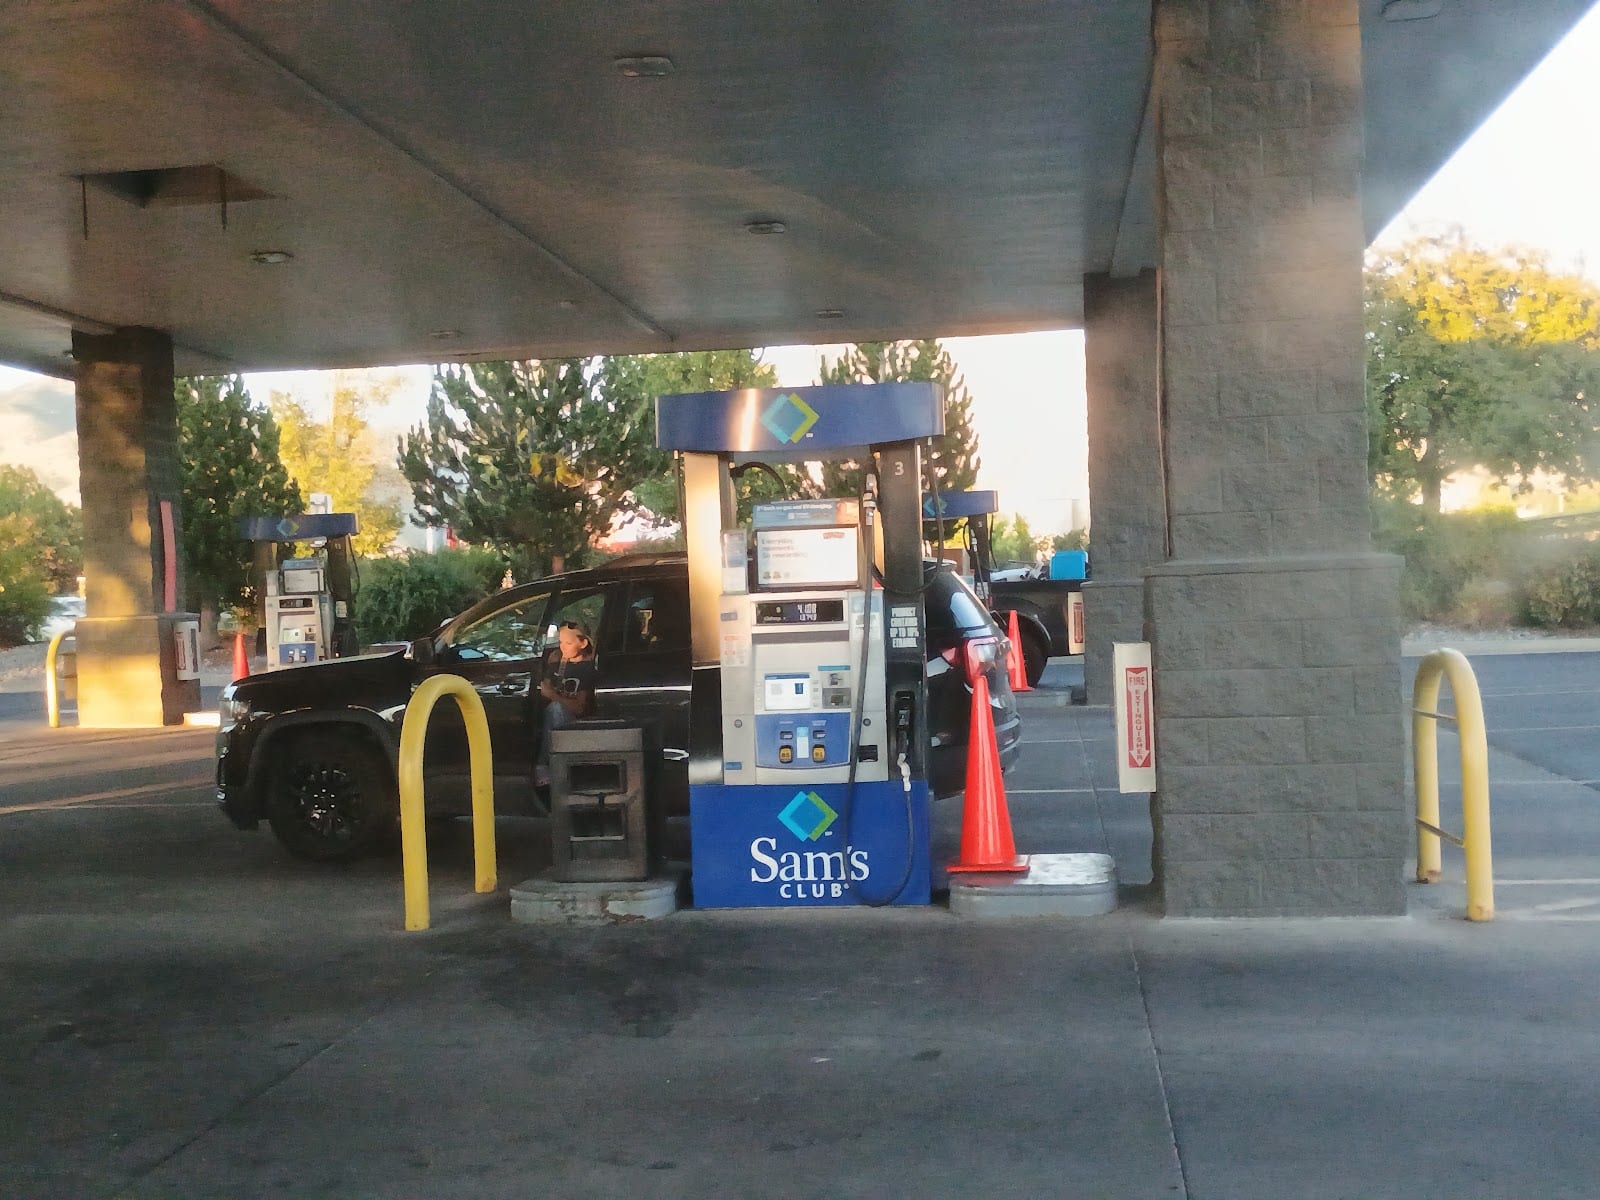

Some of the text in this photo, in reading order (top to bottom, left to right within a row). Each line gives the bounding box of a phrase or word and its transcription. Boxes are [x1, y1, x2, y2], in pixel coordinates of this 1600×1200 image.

[894, 461, 905, 476] 3
[1129, 676, 1145, 686] FIRE
[1135, 689, 1143, 760] EXTINGUISHER
[750, 837, 870, 882] Sam's
[779, 883, 843, 898] CLUB
